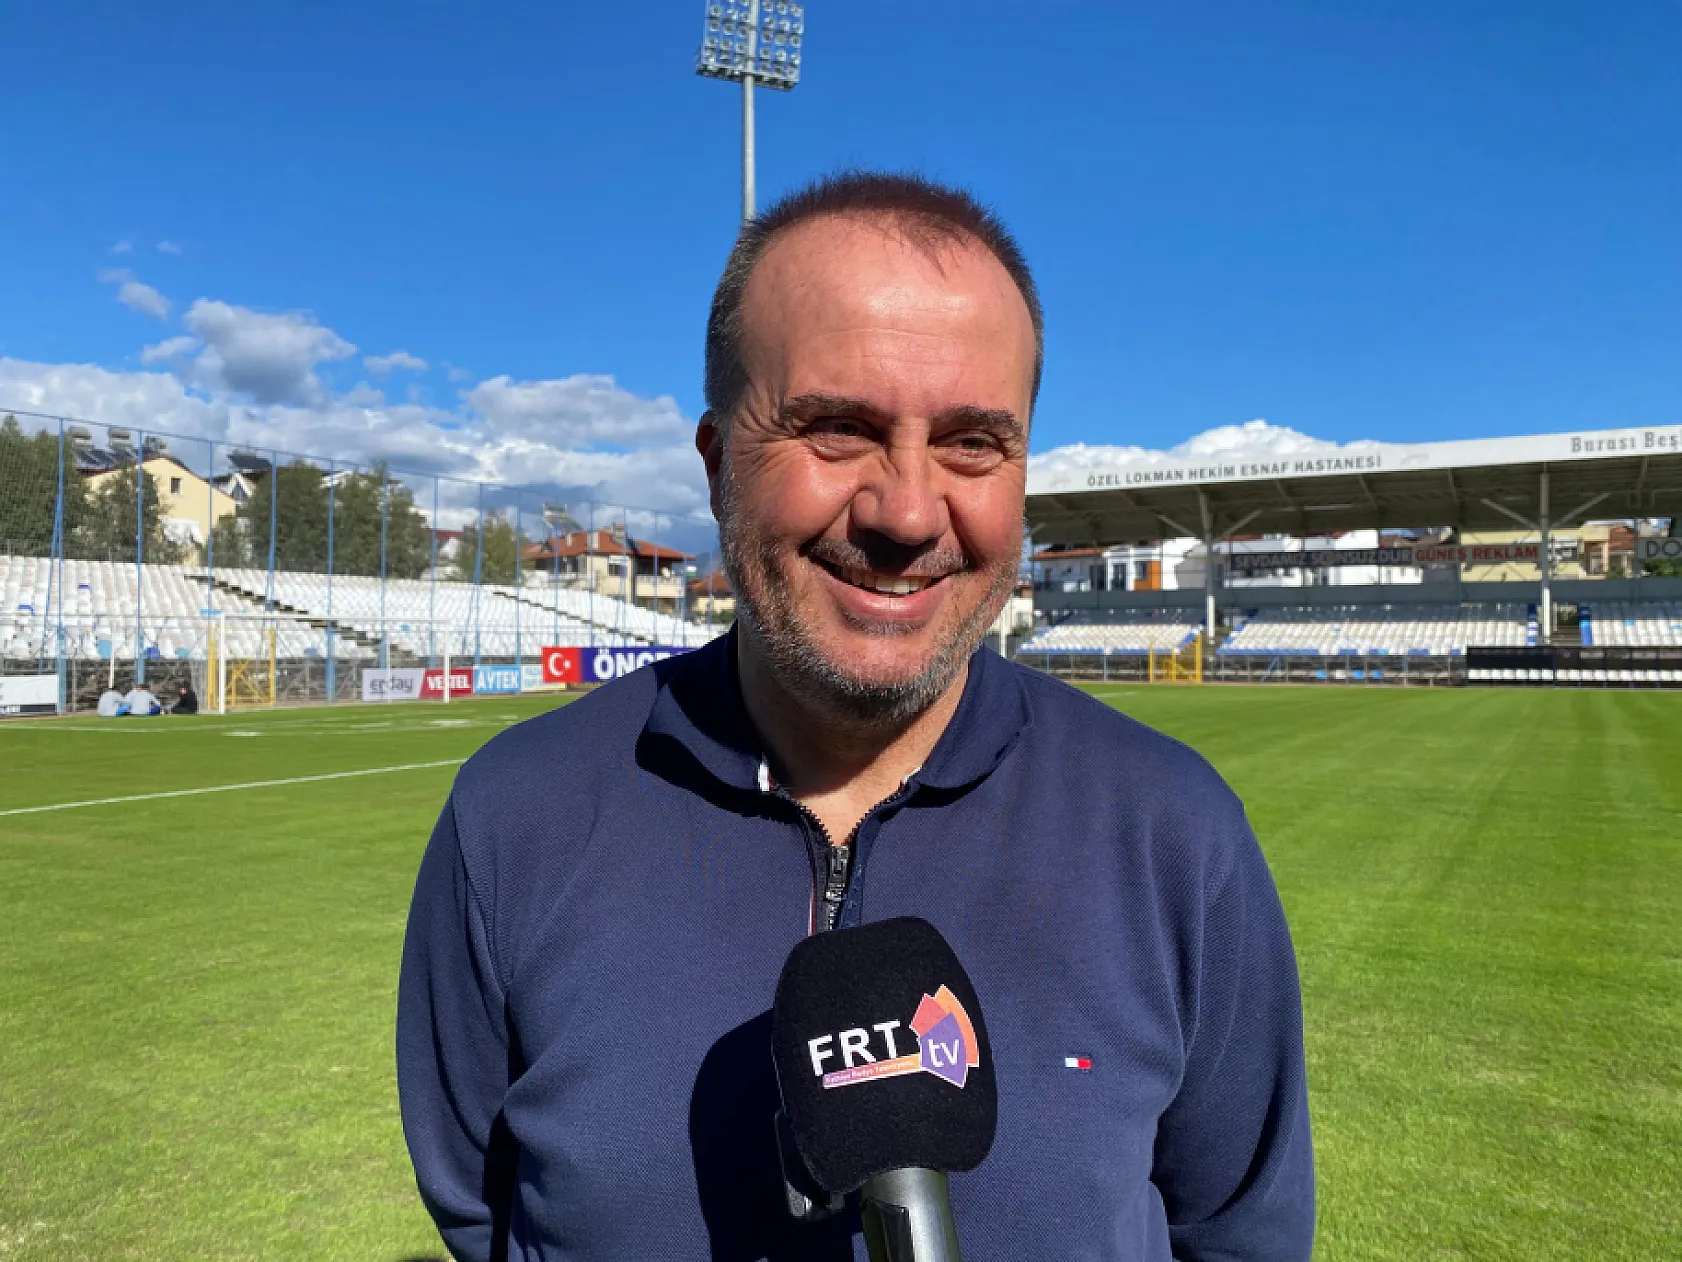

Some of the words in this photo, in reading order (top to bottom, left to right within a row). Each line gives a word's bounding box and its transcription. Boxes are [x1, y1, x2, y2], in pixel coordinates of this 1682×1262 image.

[1644, 431, 1682, 451] Beş
[1087, 472, 1121, 487] ÖZEL
[1126, 468, 1184, 485] LOKMAN
[1188, 464, 1236, 481] HEKİM
[1240, 461, 1288, 477] ESNAF
[1294, 454, 1382, 473] HASTANESİ
[1472, 545, 1539, 561] REKLAM
[593, 648, 671, 680] ÖNC
[426, 675, 471, 690] VETEL
[807, 1020, 901, 1077] FRT
[928, 1038, 960, 1068] tv
